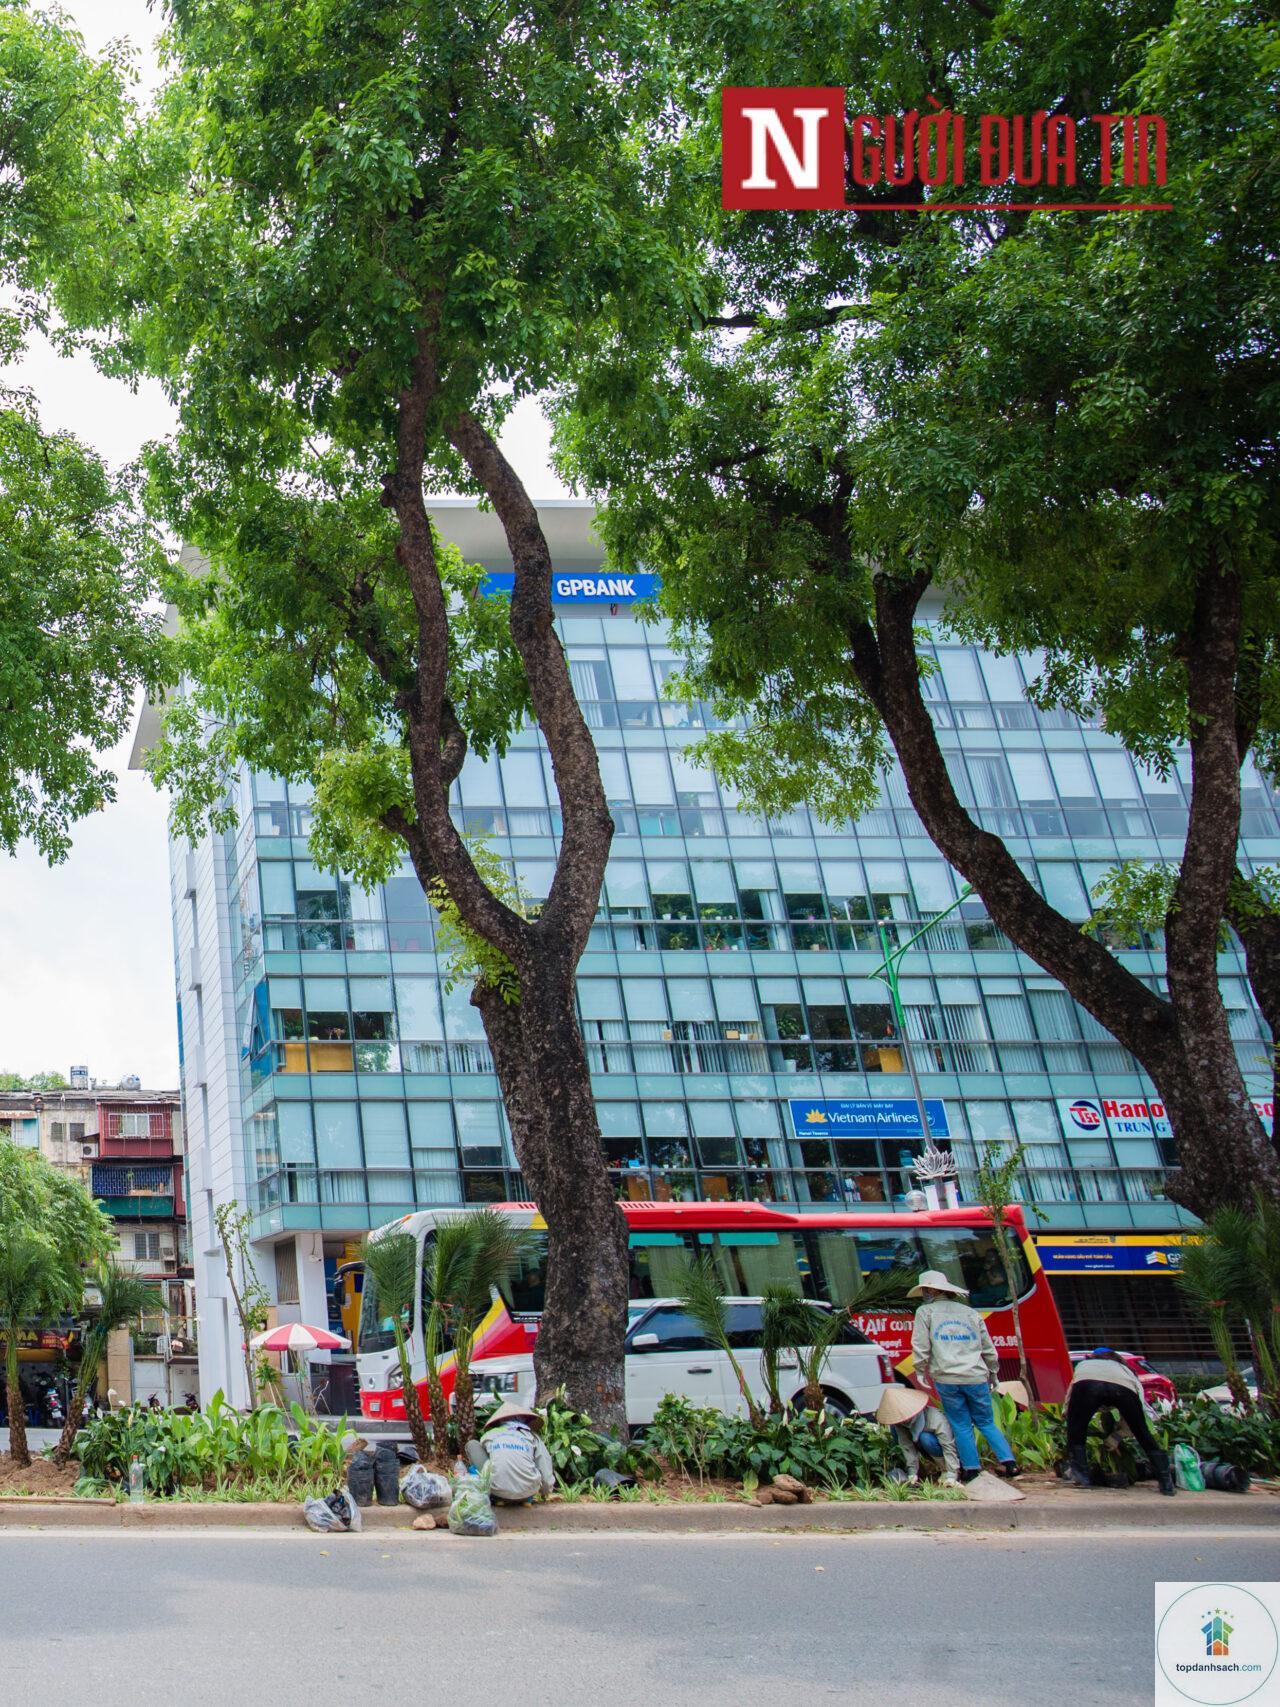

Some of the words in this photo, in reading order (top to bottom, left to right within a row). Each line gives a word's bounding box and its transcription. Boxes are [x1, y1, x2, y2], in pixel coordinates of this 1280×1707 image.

[557, 579, 637, 597] GPBANK
[828, 1112, 876, 1123] Vietnam
[877, 1112, 919, 1123] Airlines
[1103, 1100, 1165, 1118] Hano
